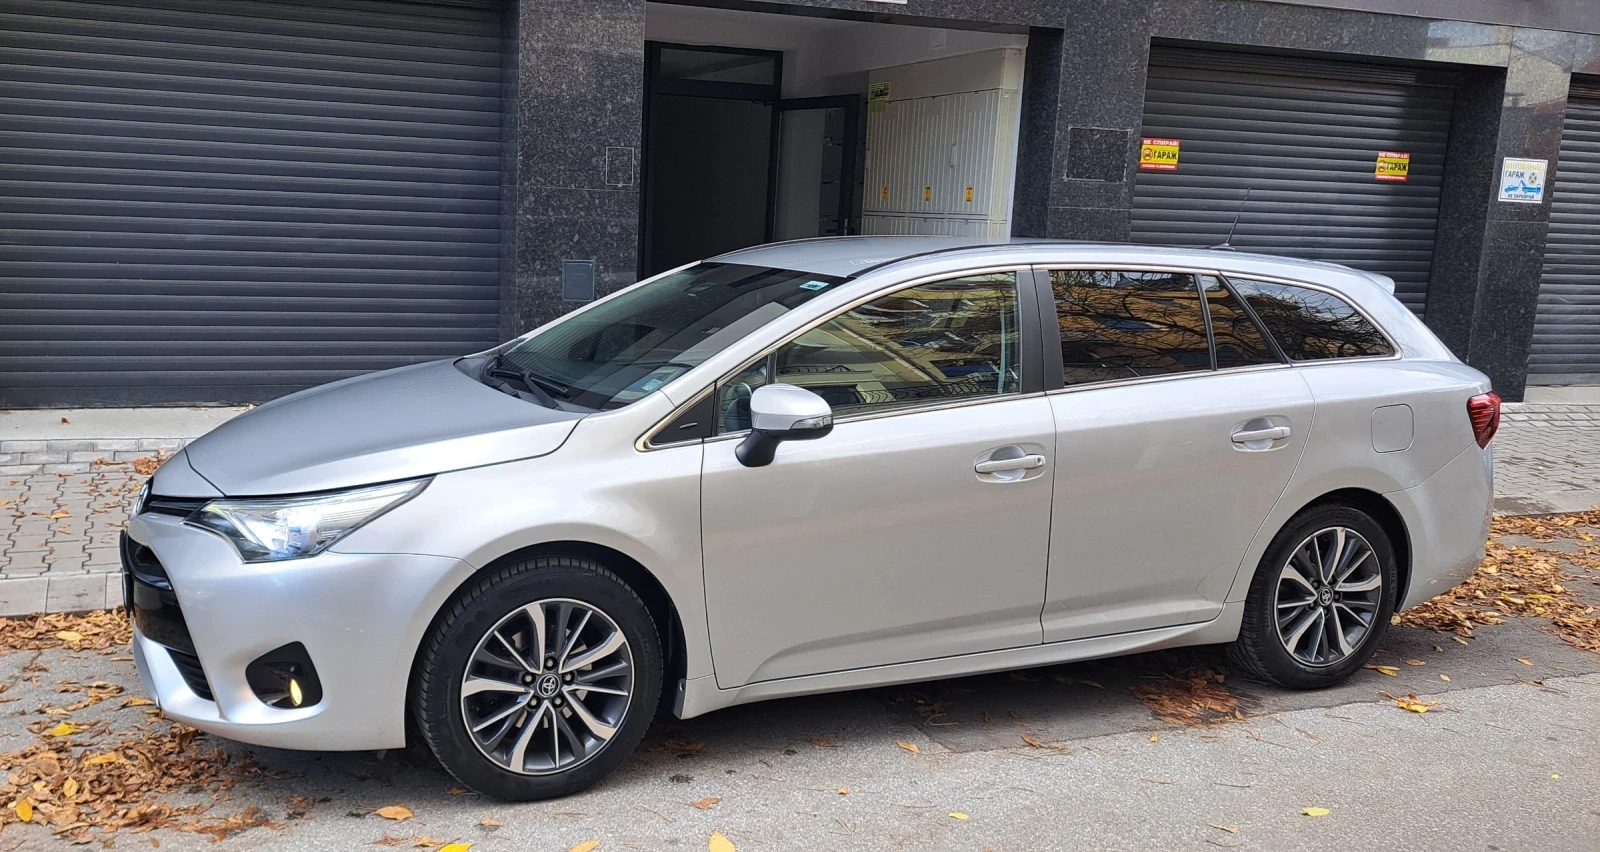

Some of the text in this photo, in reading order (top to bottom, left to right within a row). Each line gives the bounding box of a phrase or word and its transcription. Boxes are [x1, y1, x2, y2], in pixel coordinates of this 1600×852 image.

[1153, 150, 1177, 159] ГАРАЖ
[1386, 162, 1407, 171] ГАРАЖ
[1505, 170, 1525, 179] ГАРАЖ
